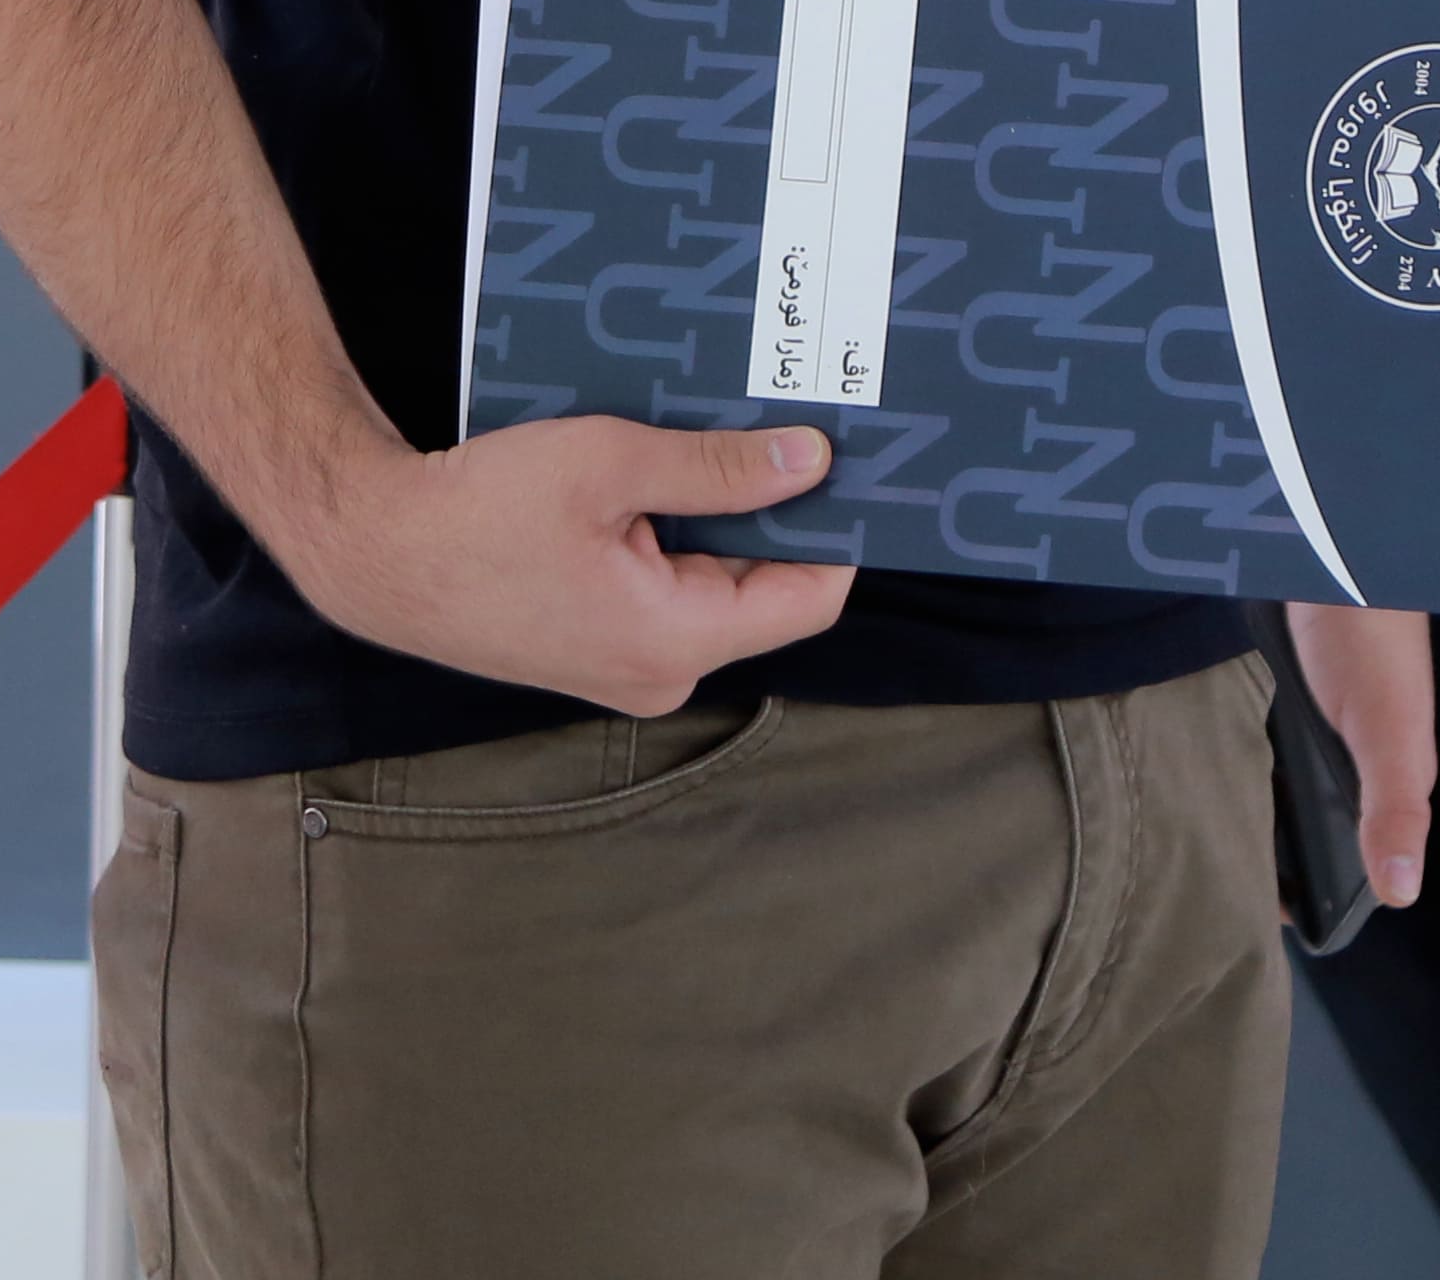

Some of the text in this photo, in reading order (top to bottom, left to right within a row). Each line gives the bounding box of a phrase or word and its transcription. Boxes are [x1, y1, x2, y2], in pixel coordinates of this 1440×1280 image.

[1414, 60, 1431, 96] 2004
[1398, 255, 1414, 292] 2704
[772, 338, 805, 390] ژمارا
